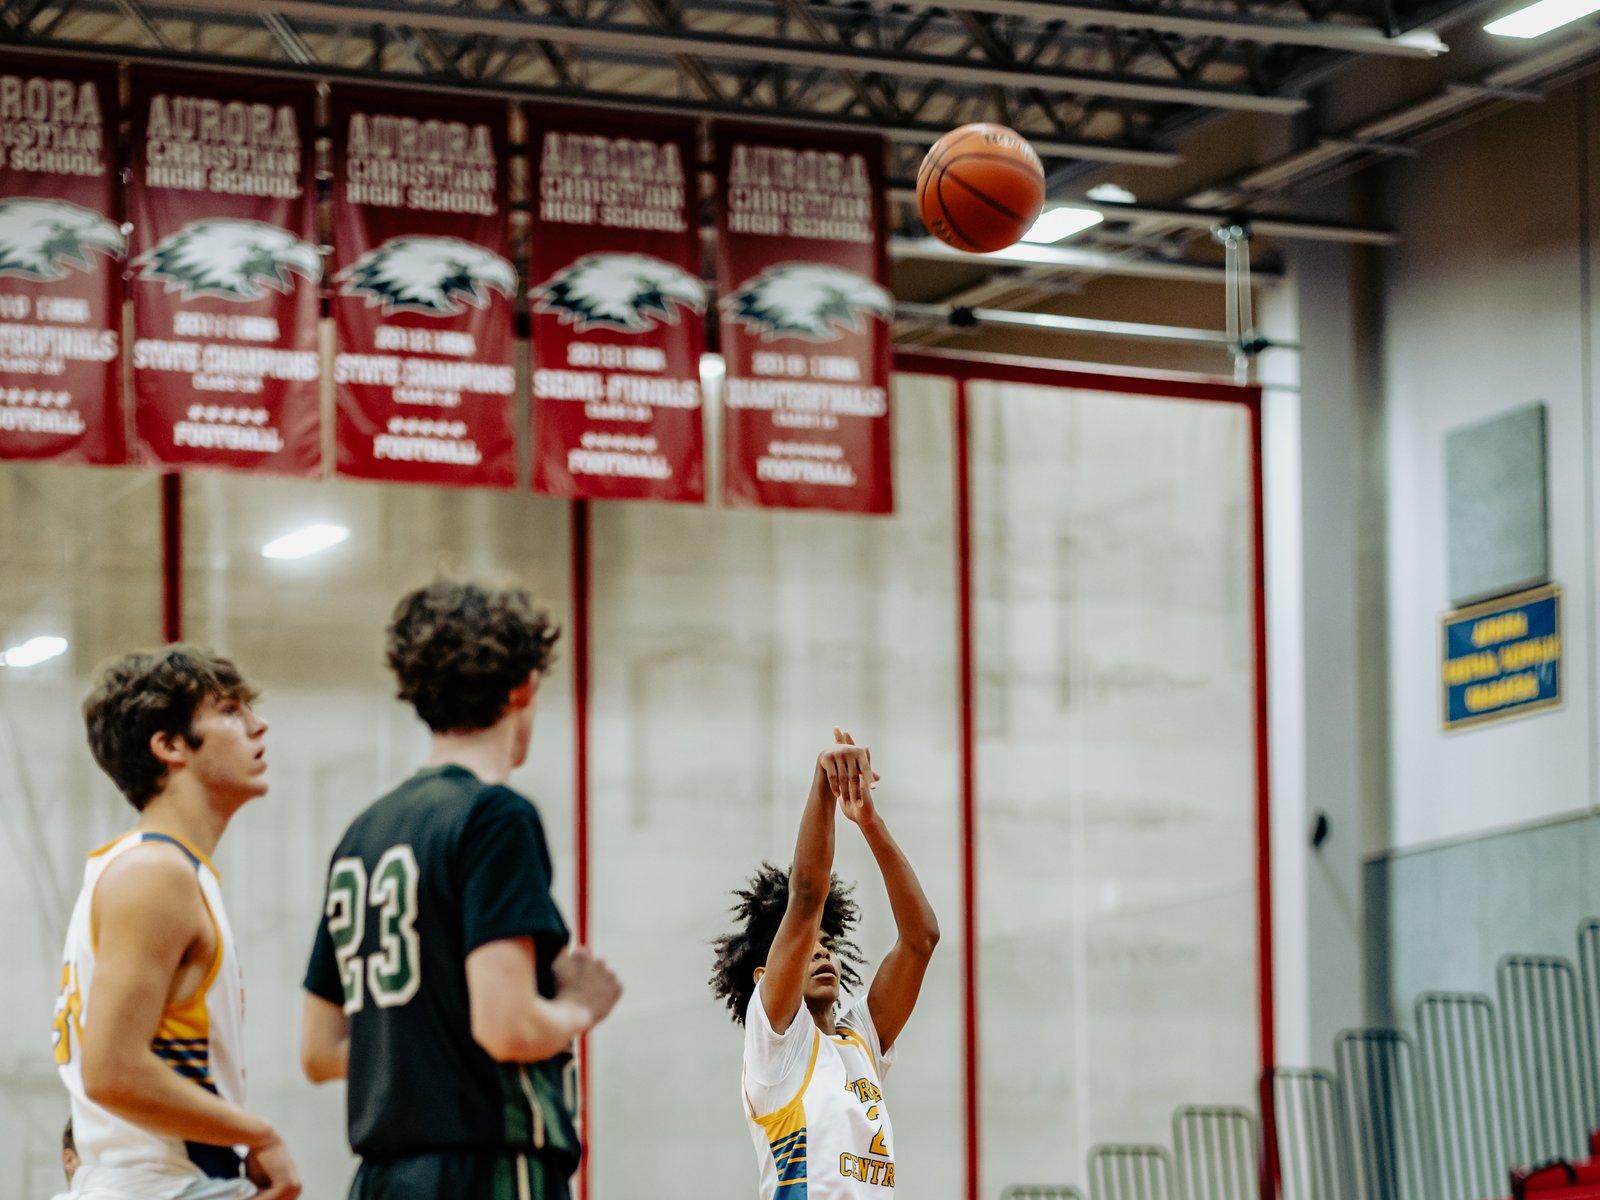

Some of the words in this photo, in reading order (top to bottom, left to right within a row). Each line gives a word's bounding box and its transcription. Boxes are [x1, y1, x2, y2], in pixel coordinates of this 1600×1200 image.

[147, 93, 300, 147] AURORA
[347, 112, 497, 164] AURORA
[10, 148, 106, 176] SCHOOL
[146, 139, 301, 173] CHRISTIAN
[540, 131, 685, 184] AURORA
[145, 165, 207, 190] HIGH
[209, 171, 303, 199] SCHOOL
[407, 188, 498, 216] SCHOOL
[325, 843, 420, 1017] 23
